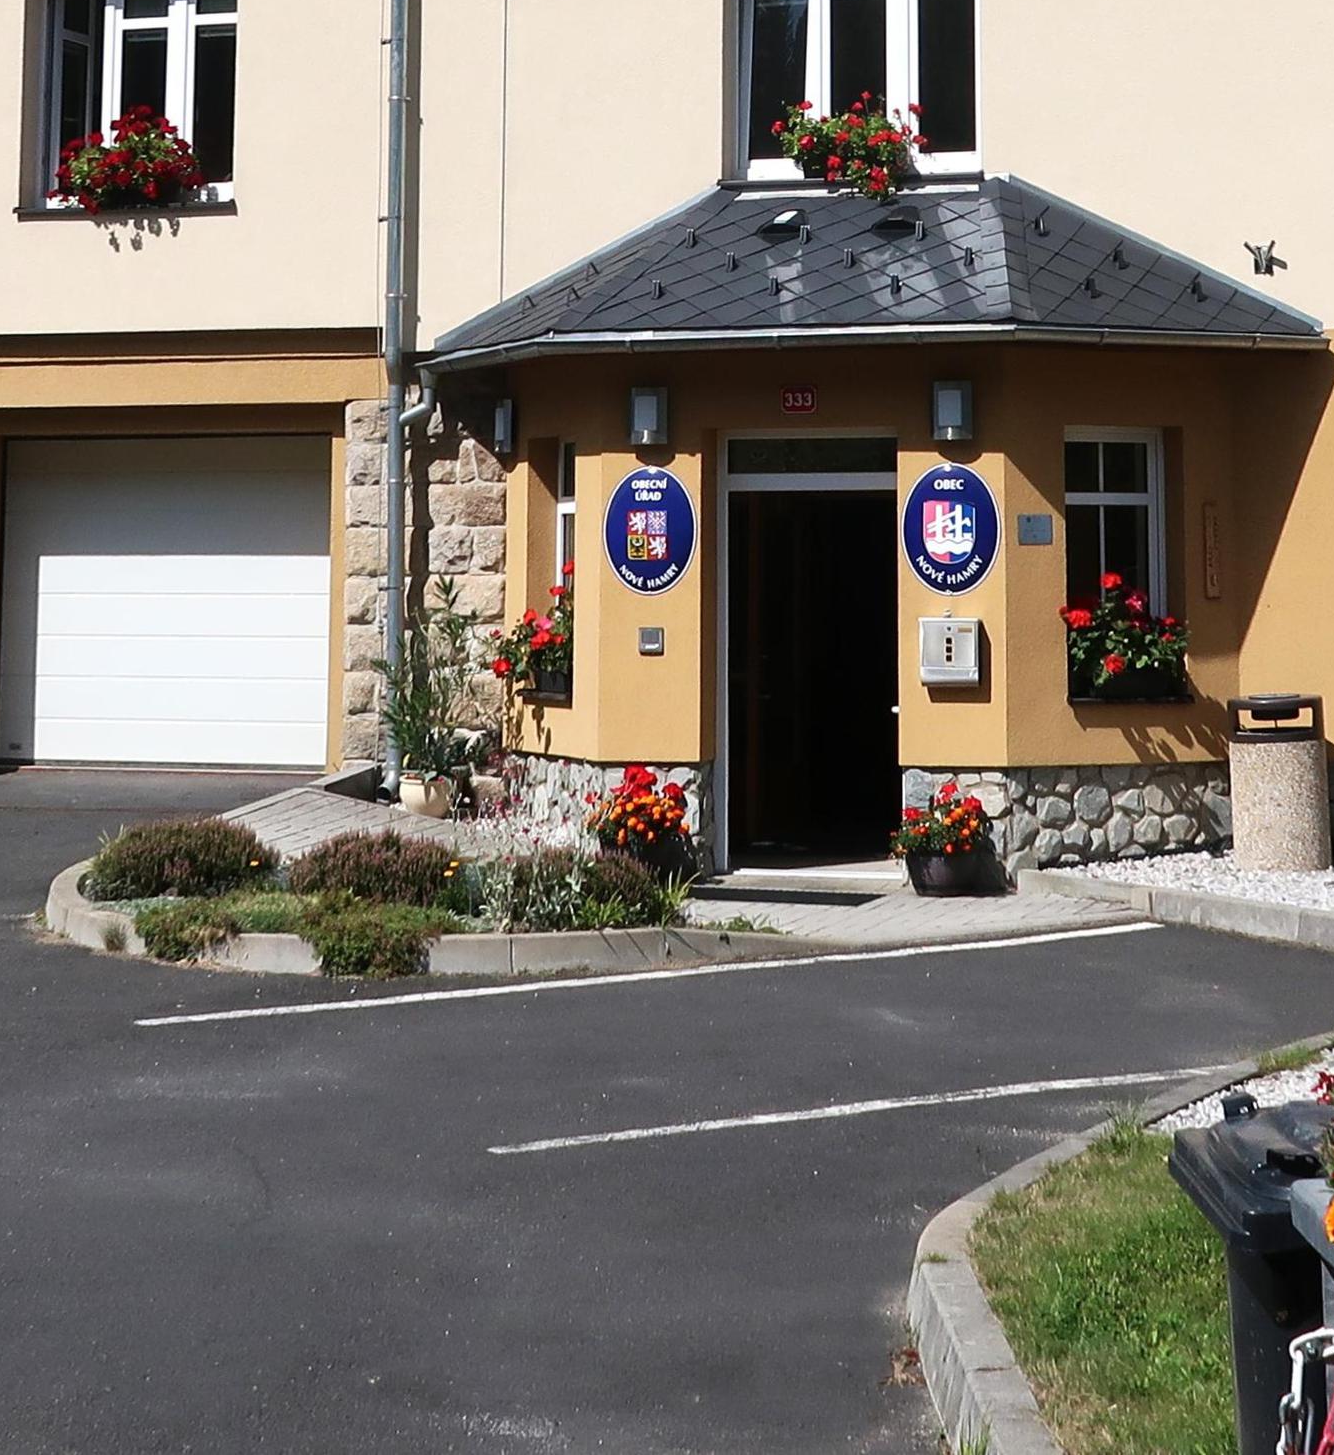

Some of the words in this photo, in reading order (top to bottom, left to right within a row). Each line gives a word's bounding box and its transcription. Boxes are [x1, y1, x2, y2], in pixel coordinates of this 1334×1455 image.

[784, 392, 812, 407] 333
[631, 477, 668, 491] OBECNÍ
[933, 479, 965, 491] OBEC
[634, 489, 663, 502] ÚŘAD
[618, 564, 644, 588] NOVÉ
[646, 563, 679, 589] HAMRY
[915, 554, 946, 584] NOVÉ
[947, 554, 984, 585] HAMRY
